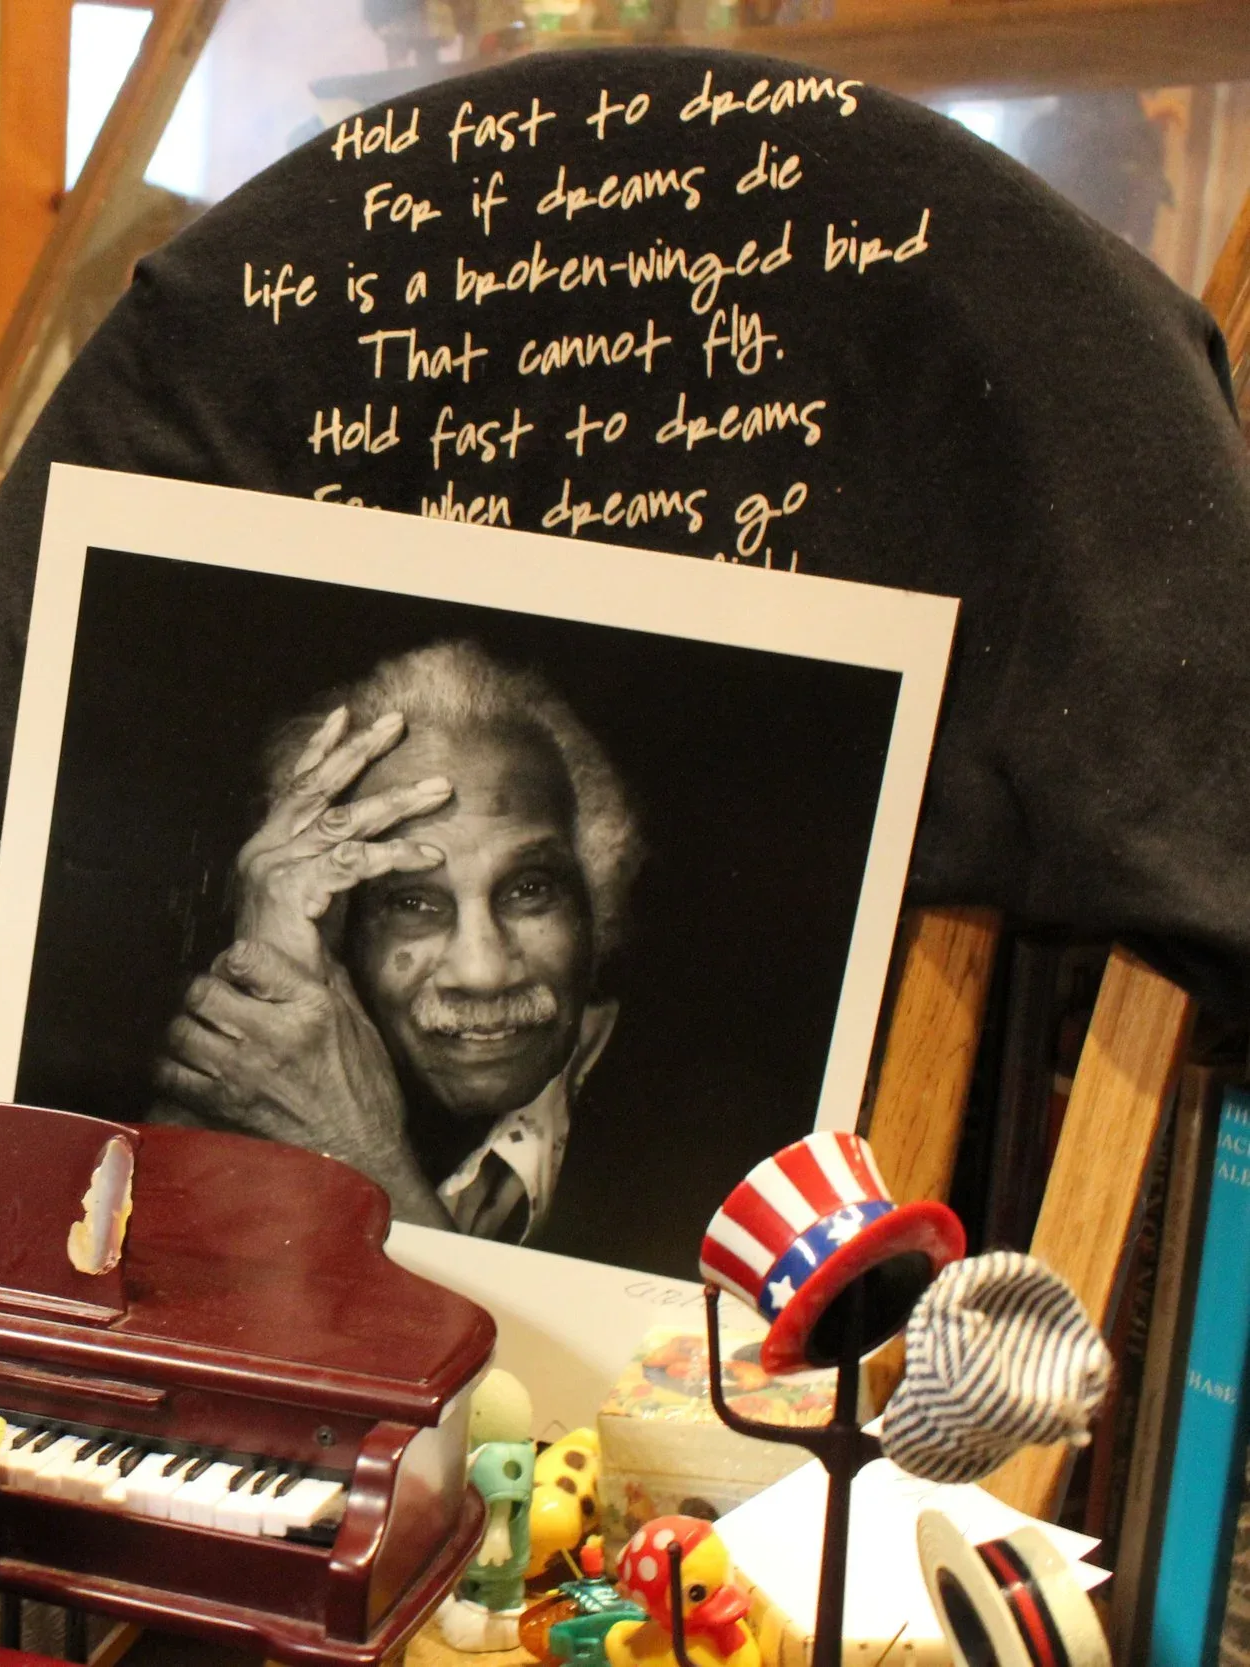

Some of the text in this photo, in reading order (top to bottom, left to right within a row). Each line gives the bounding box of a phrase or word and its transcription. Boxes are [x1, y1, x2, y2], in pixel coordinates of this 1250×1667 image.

[329, 70, 867, 164] Hold fast to dreams
[363, 140, 803, 235] For if dreams die
[243, 207, 930, 325] Life is a broken-winged bird
[357, 308, 786, 384] That cannot fly.
[307, 393, 827, 470] Hold fast to dreams
[420, 480, 512, 527] when
[541, 478, 708, 536] dreams
[734, 481, 808, 557] go
